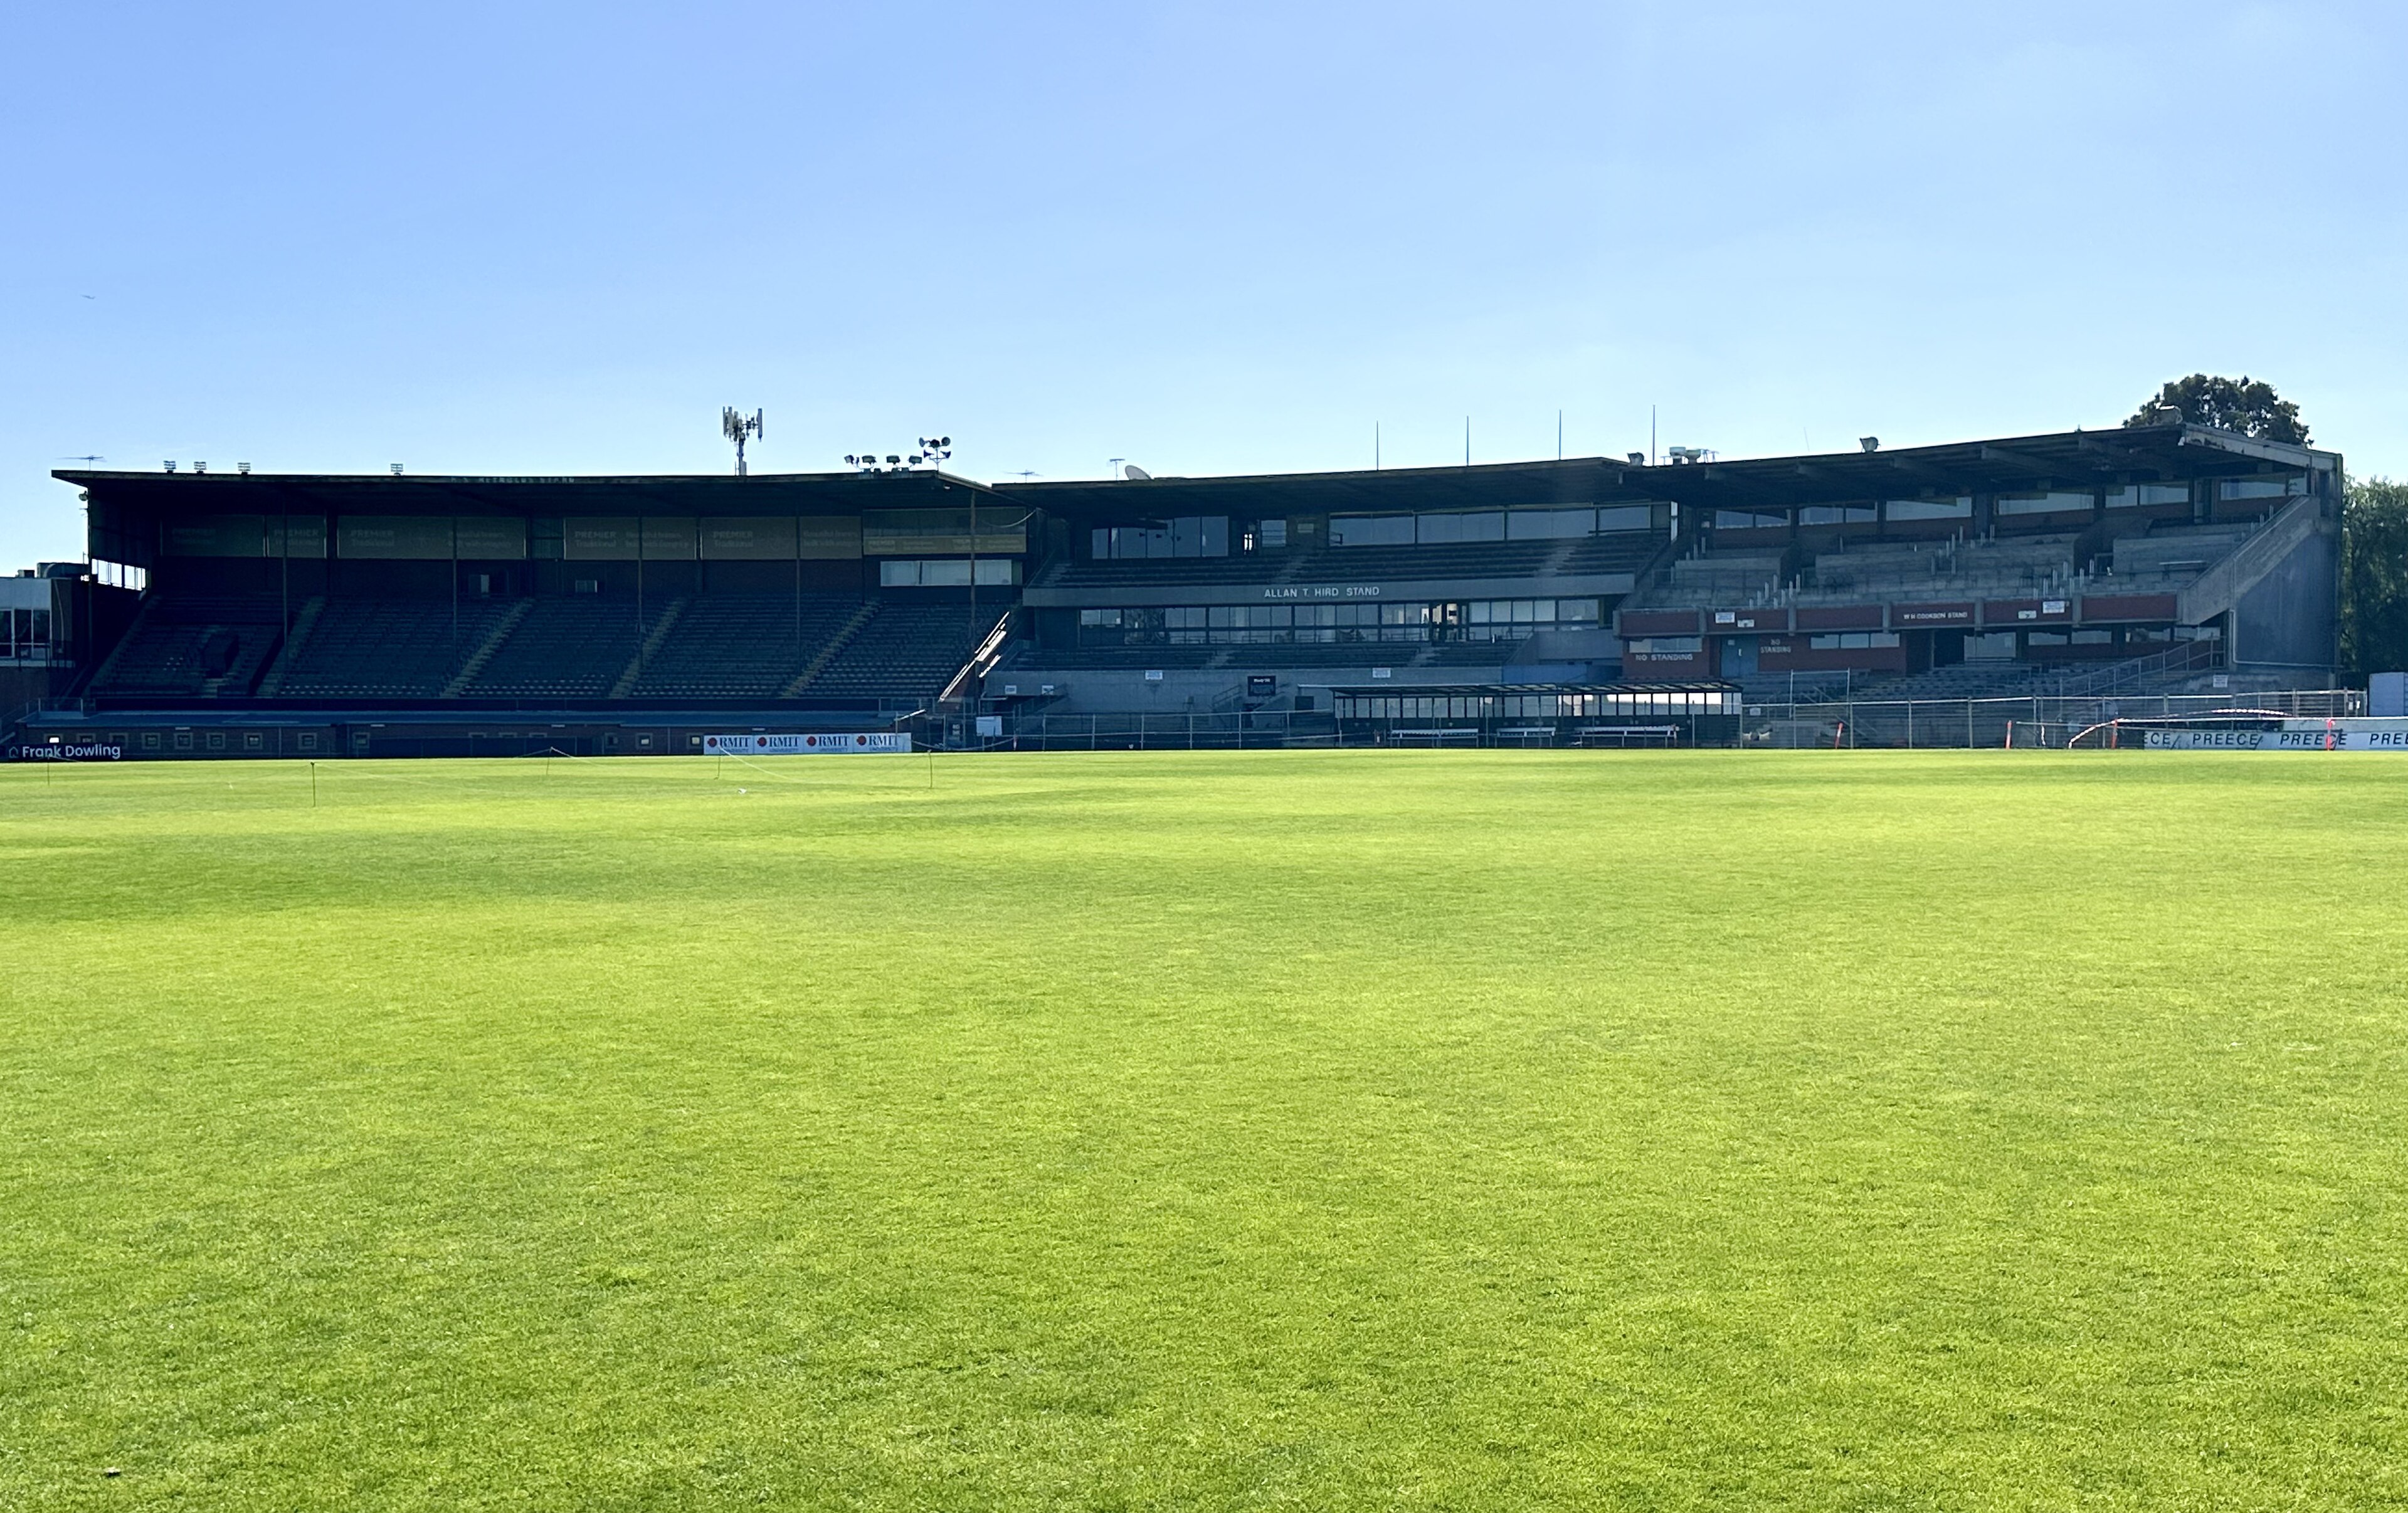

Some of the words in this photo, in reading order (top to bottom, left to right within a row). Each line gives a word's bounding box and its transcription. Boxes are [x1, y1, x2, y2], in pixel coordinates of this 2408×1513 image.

[1264, 588, 1297, 598] ALLAN
[1314, 587, 1339, 597] HIRD
[1346, 586, 1380, 596] STAND
[1651, 653, 1693, 662] STANDING
[719, 737, 749, 747] RMIT
[769, 737, 799, 747] RMIT
[818, 736, 848, 746] RMIT
[868, 735, 898, 746] RMIT
[2192, 733, 2259, 746] PREECE
[23, 745, 62, 758] Frank
[65, 743, 121, 760] Dowling
